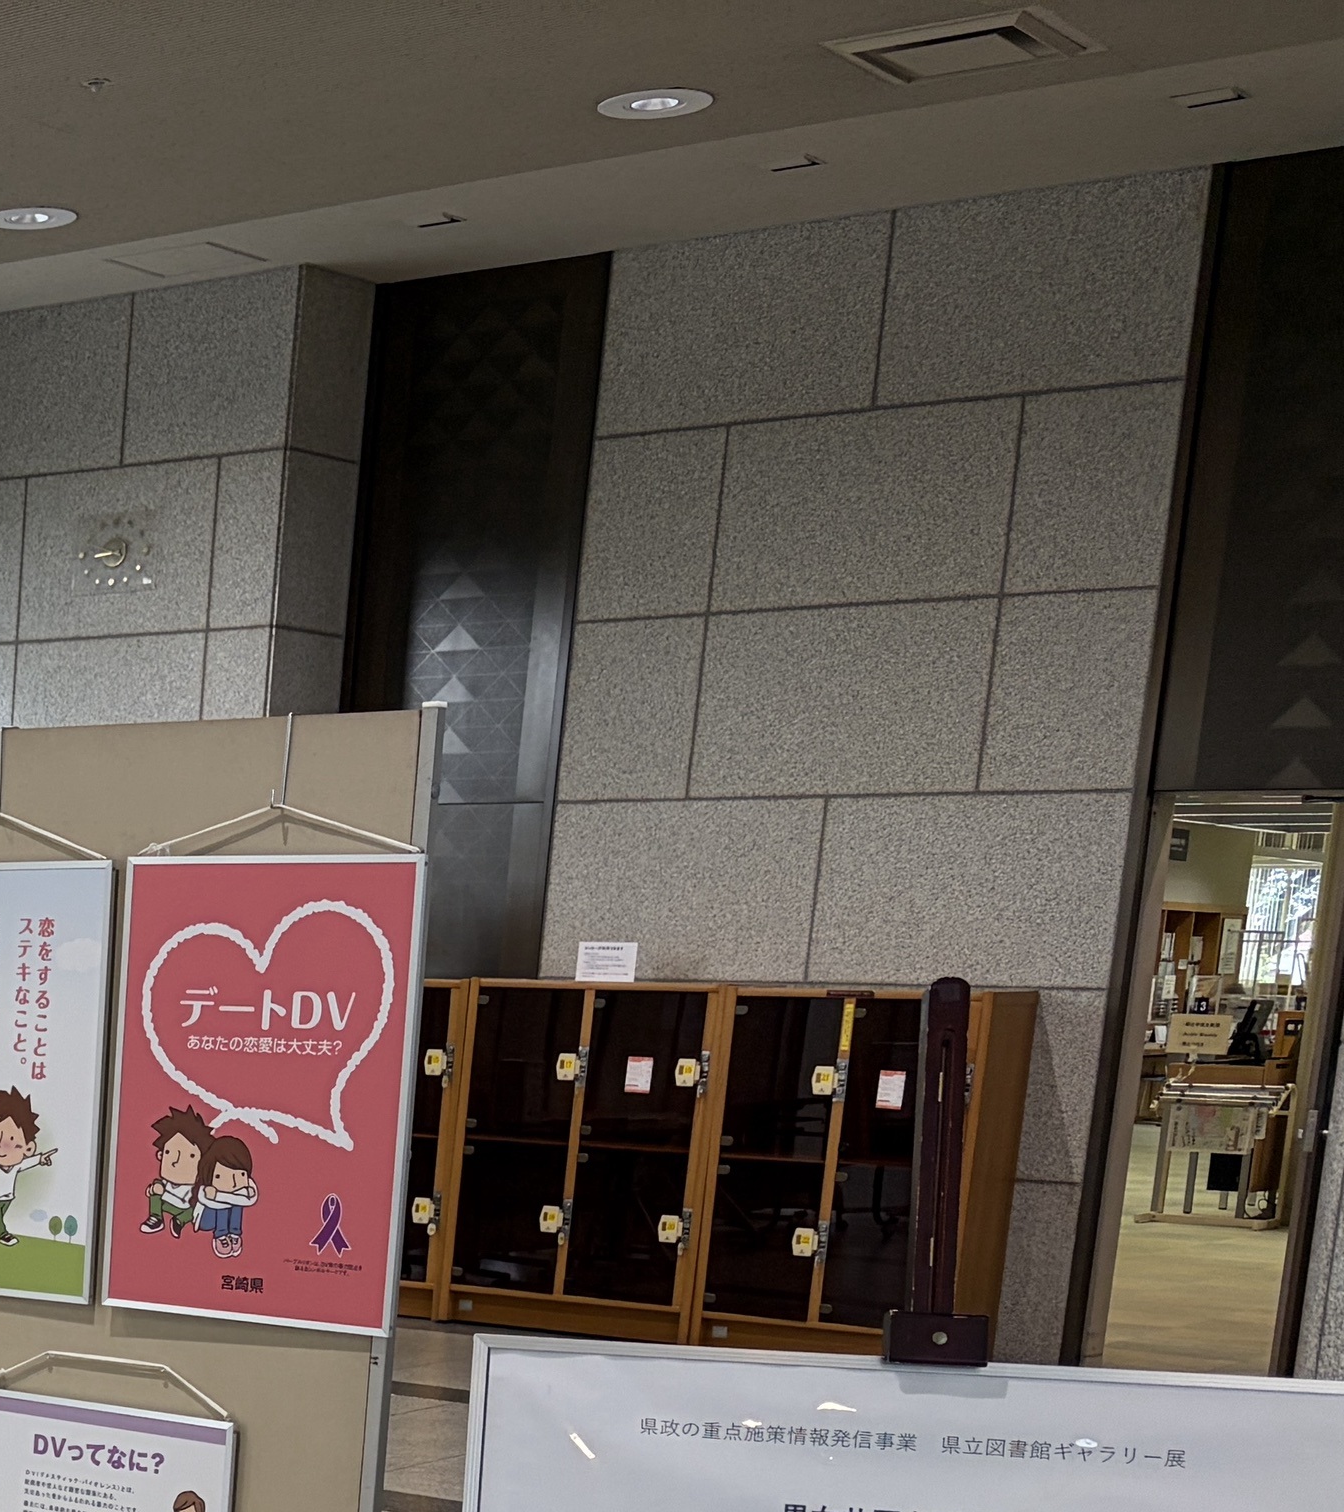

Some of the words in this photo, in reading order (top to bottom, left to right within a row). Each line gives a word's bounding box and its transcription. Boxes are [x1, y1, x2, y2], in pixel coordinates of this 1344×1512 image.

[13, 918, 33, 1064] ステキなこと。
[31, 917, 56, 1080] 恋をすることは
[179, 986, 357, 1031] デートDV
[186, 1034, 343, 1057] あなたの恋愛は大丈夫？
[221, 1275, 264, 1293] 宮崎県
[33, 1433, 165, 1474] DVってなに？
[639, 1416, 918, 1454] 県政の重点施策情報発信事業
[941, 1435, 1187, 1471] 県立図書館ギャラリー展
